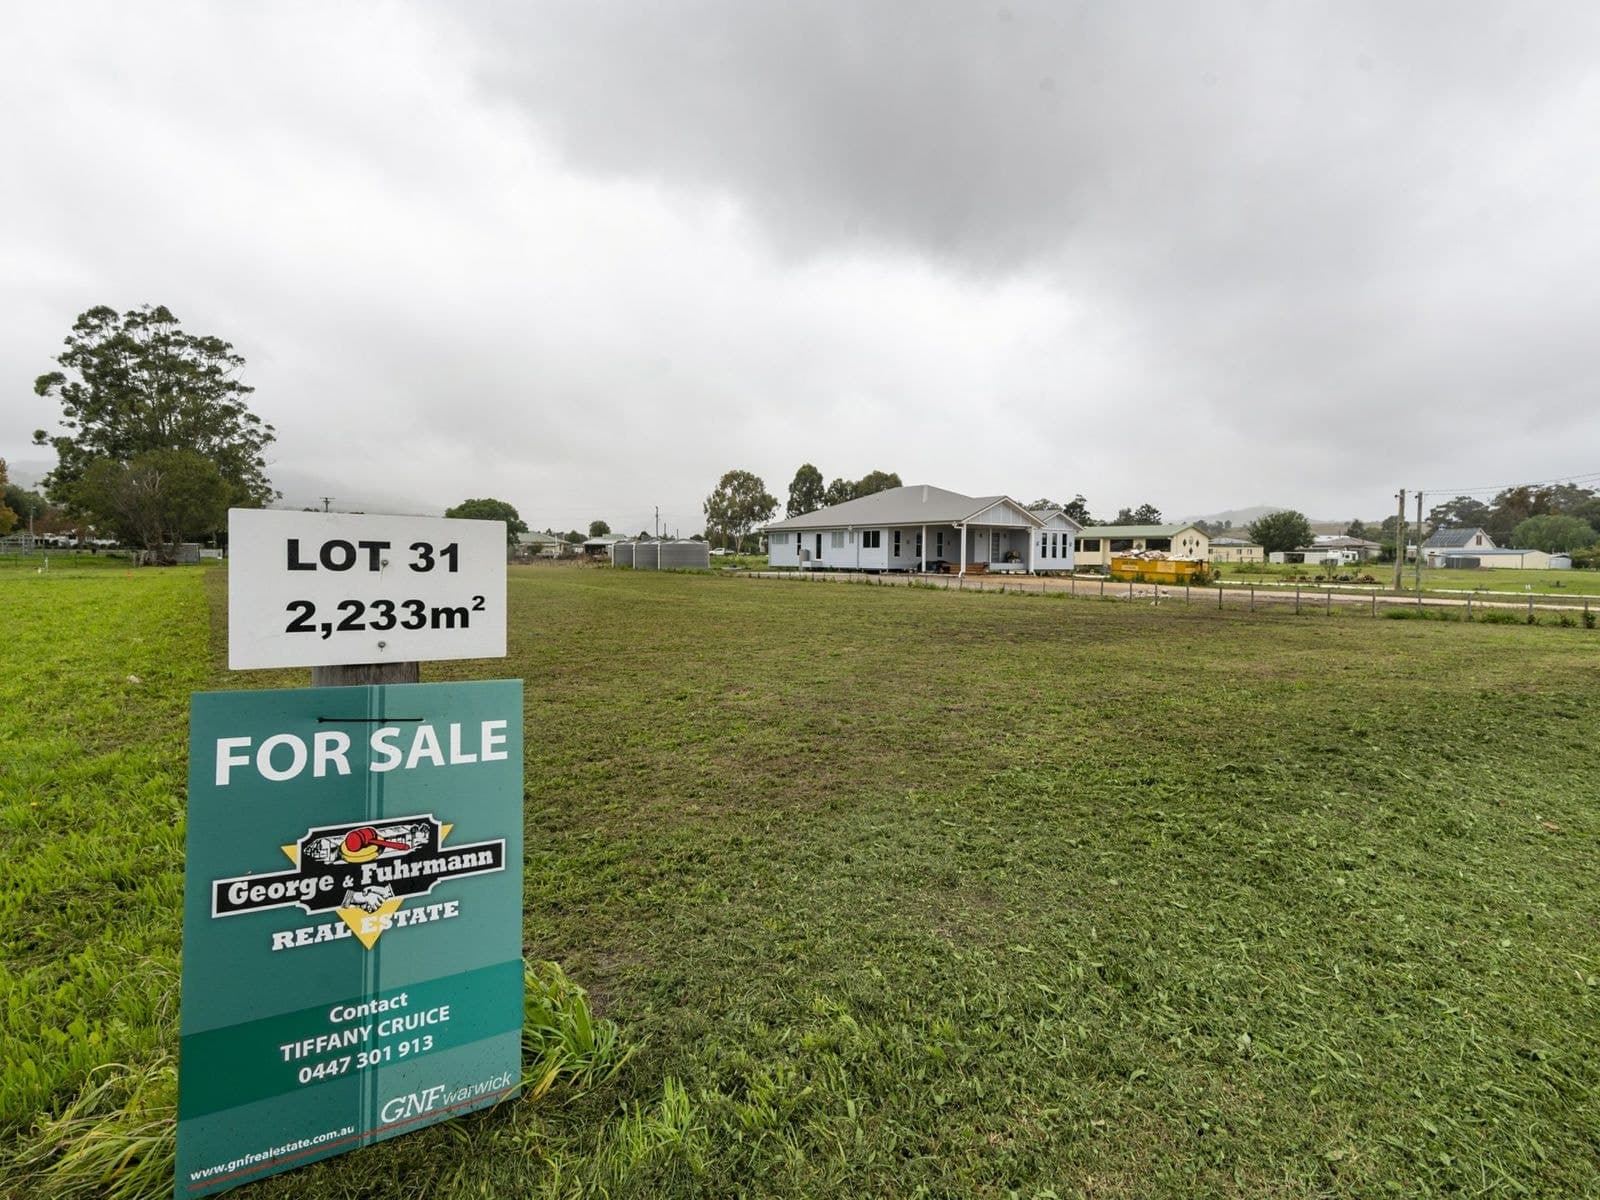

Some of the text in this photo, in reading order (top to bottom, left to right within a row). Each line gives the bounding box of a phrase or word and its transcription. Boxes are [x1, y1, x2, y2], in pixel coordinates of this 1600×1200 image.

[286, 538, 459, 573] LOT 31
[215, 720, 508, 786] FOR SALE
[228, 848, 494, 906] George & Fuhrmann
[271, 900, 460, 951] REAL ESTATE
[280, 1005, 450, 1062] TIFFANY CRUICE
[329, 992, 408, 1023] Contact
[298, 1035, 433, 1084] 0447 301 913
[190, 1125, 355, 1182] www.gnfrealestate.com.au
